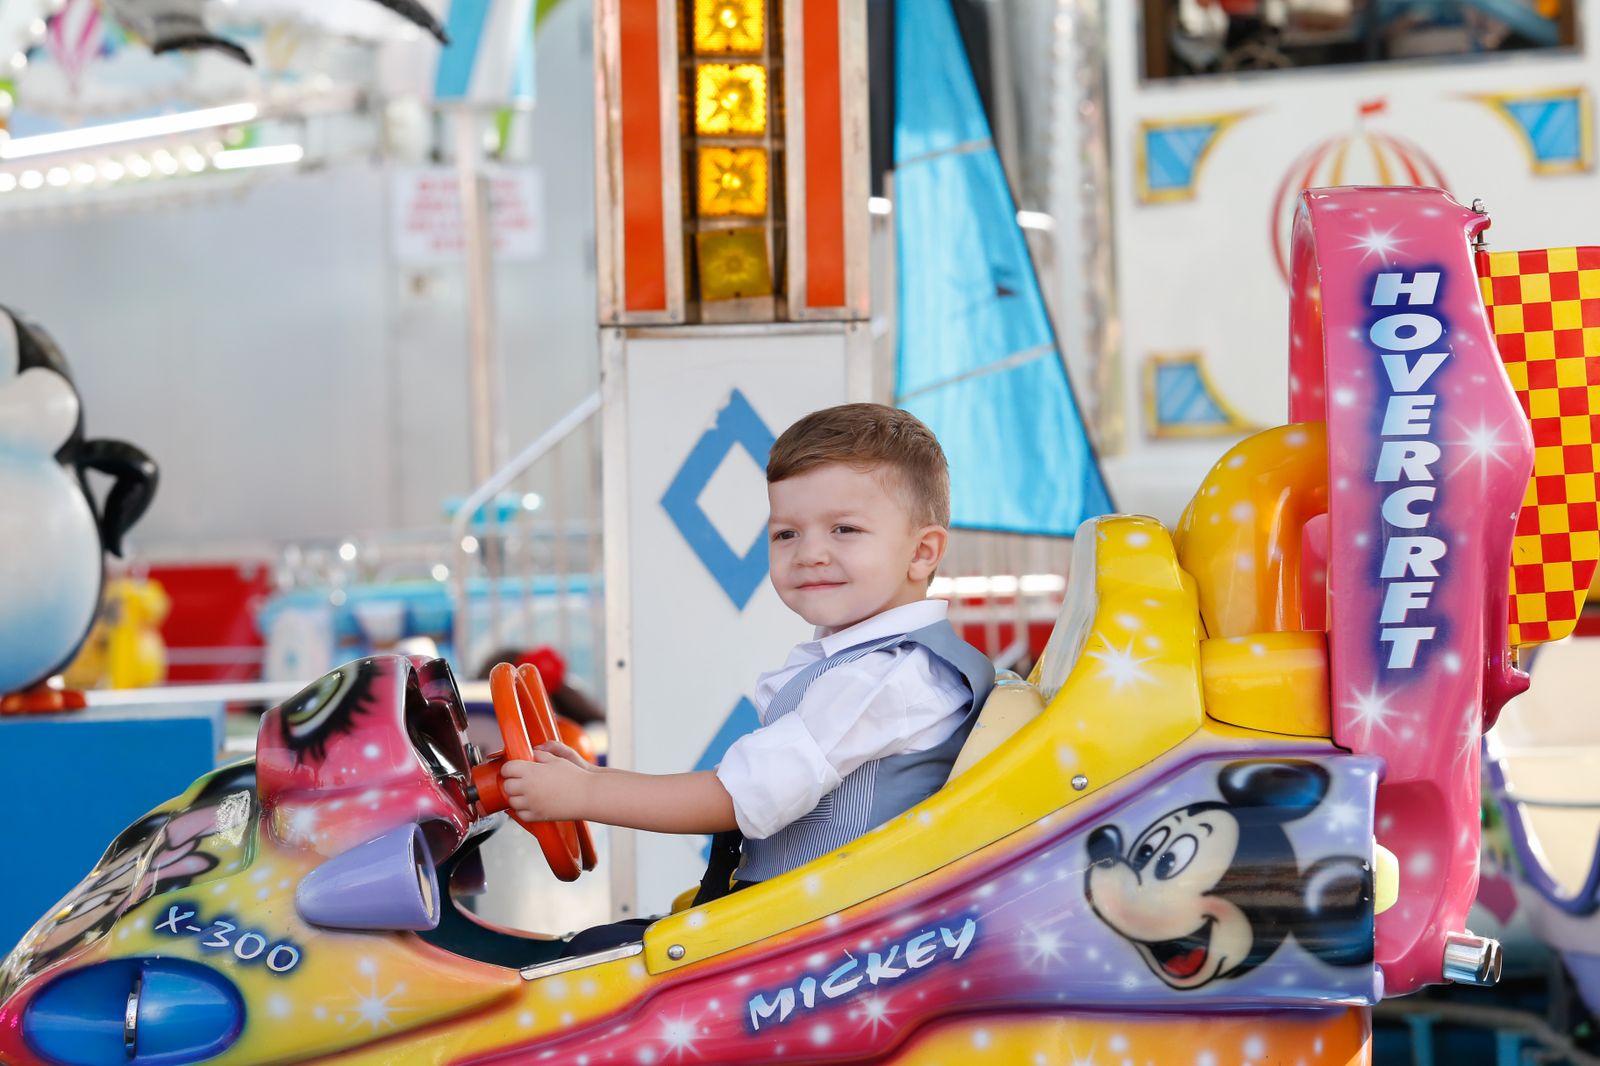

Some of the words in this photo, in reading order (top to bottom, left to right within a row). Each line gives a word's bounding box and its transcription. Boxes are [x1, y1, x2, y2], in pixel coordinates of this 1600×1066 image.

[1370, 272, 1448, 669] HOVERCRFT
[154, 905, 299, 972] X-300
[749, 919, 977, 1030] MICKEY
